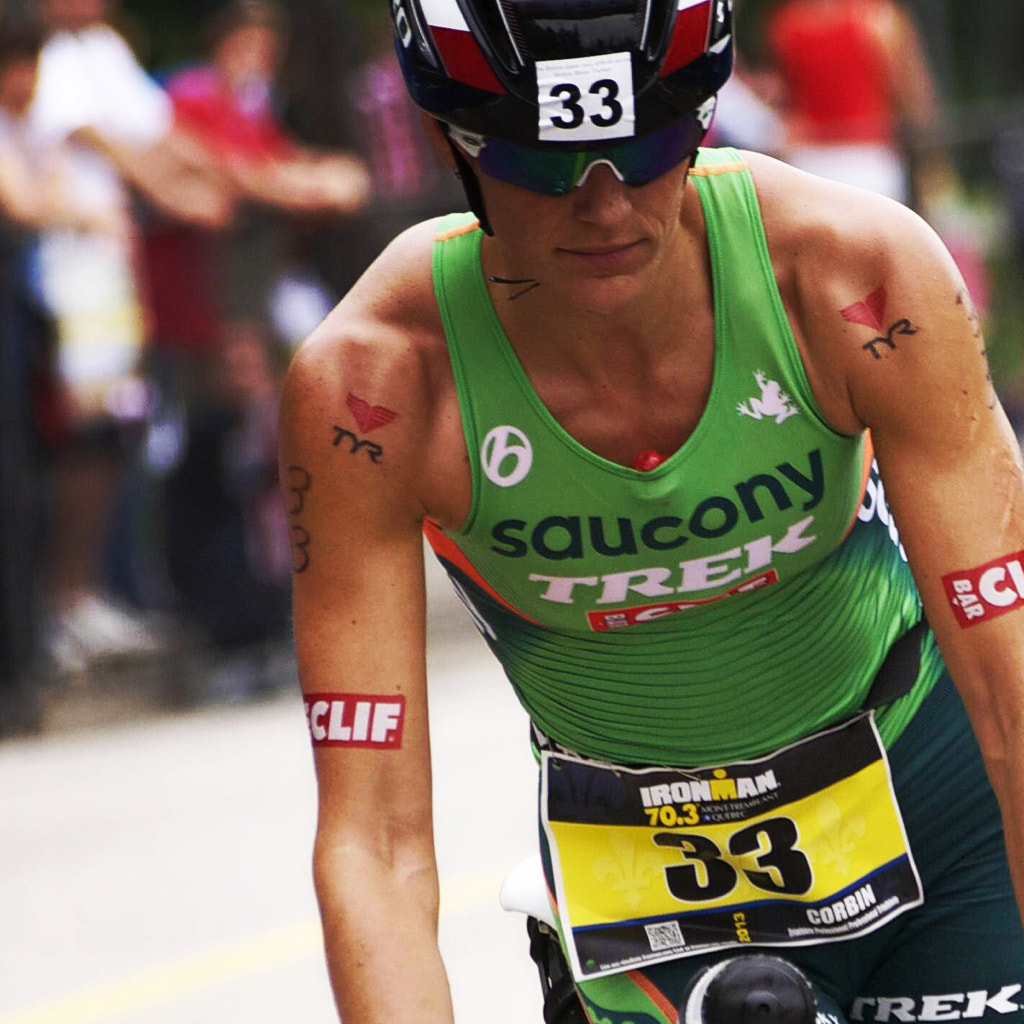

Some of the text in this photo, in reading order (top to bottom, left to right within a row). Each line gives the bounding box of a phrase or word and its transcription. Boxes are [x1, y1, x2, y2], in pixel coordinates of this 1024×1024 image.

[549, 78, 623, 129] 33
[862, 318, 918, 360] TYR
[333, 425, 383, 464] TYR
[489, 448, 826, 560] saucony
[528, 516, 817, 604] TREK
[310, 700, 402, 743] CLIF
[639, 768, 779, 807] IRONMAN
[643, 803, 700, 827] 70.3
[652, 816, 814, 903] 33
[806, 883, 877, 925] CORBIN
[732, 911, 751, 944] 2013
[850, 983, 1022, 1023] TREK
